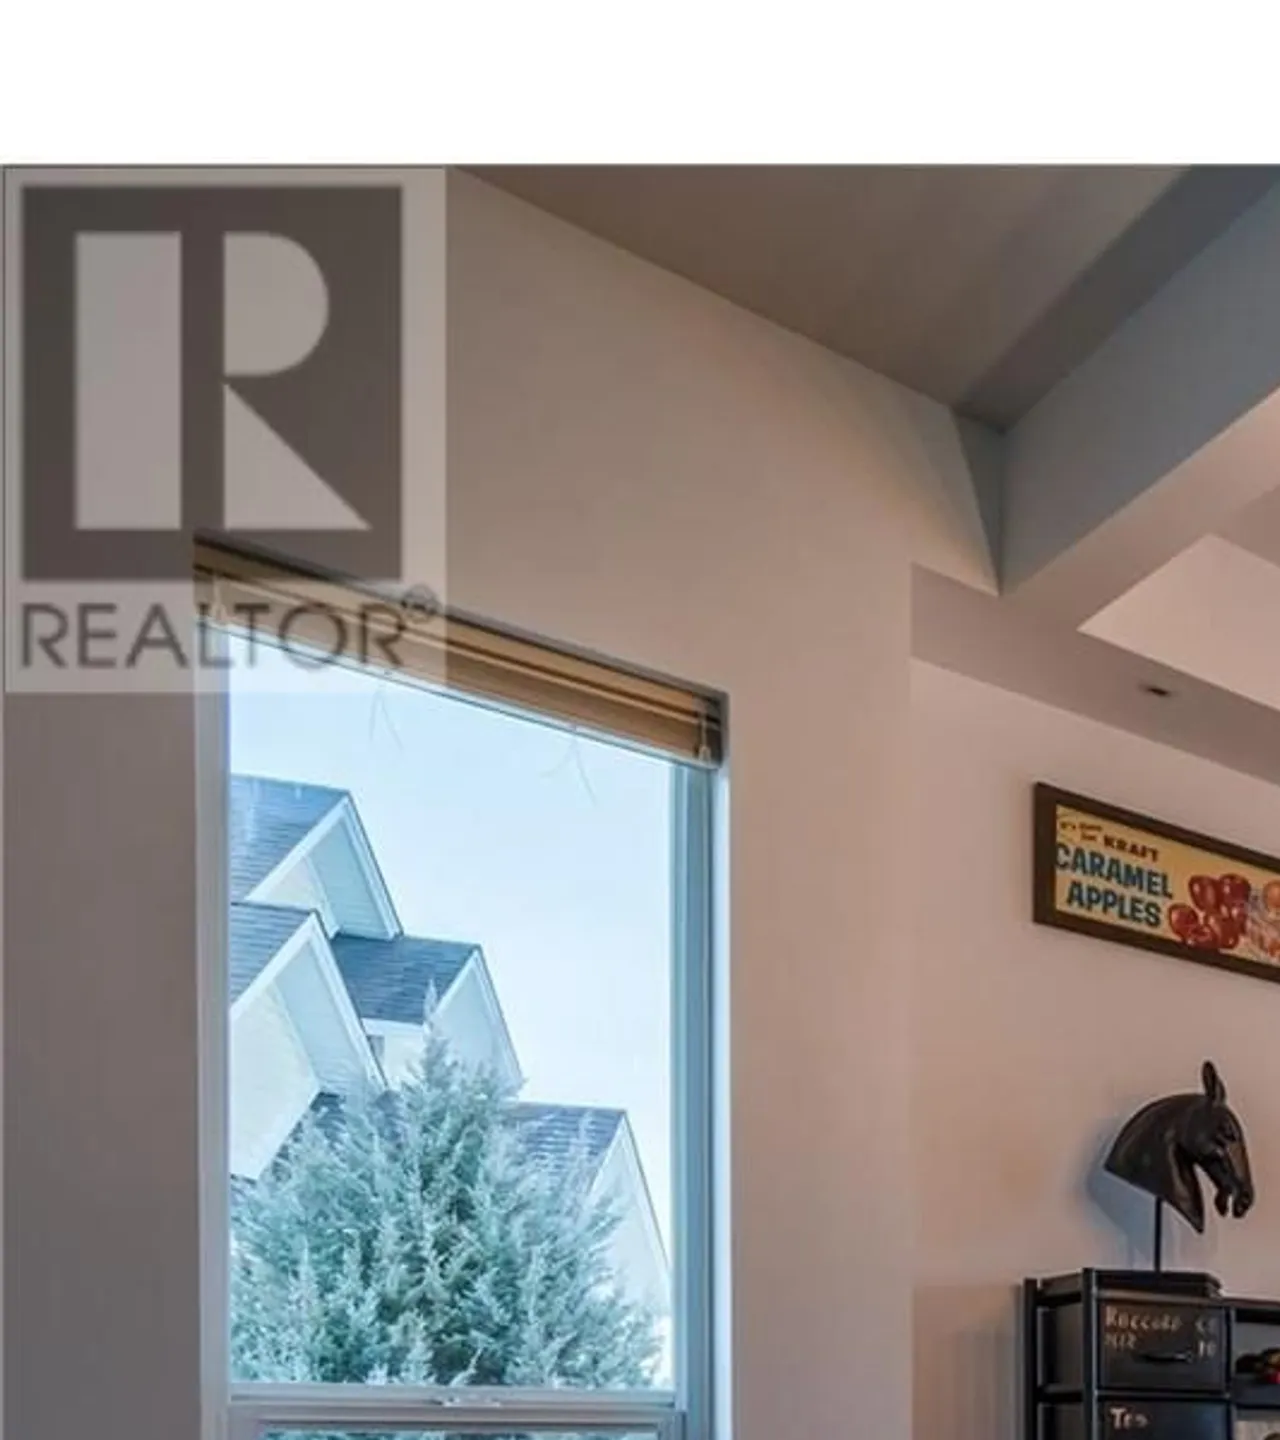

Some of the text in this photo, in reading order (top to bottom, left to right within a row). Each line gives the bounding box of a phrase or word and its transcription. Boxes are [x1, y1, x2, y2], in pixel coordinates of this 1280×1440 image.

[1055, 842, 1173, 899] CARAMEL
[1103, 834, 1159, 862] KRAFT
[1067, 880, 1161, 928] APPLES
